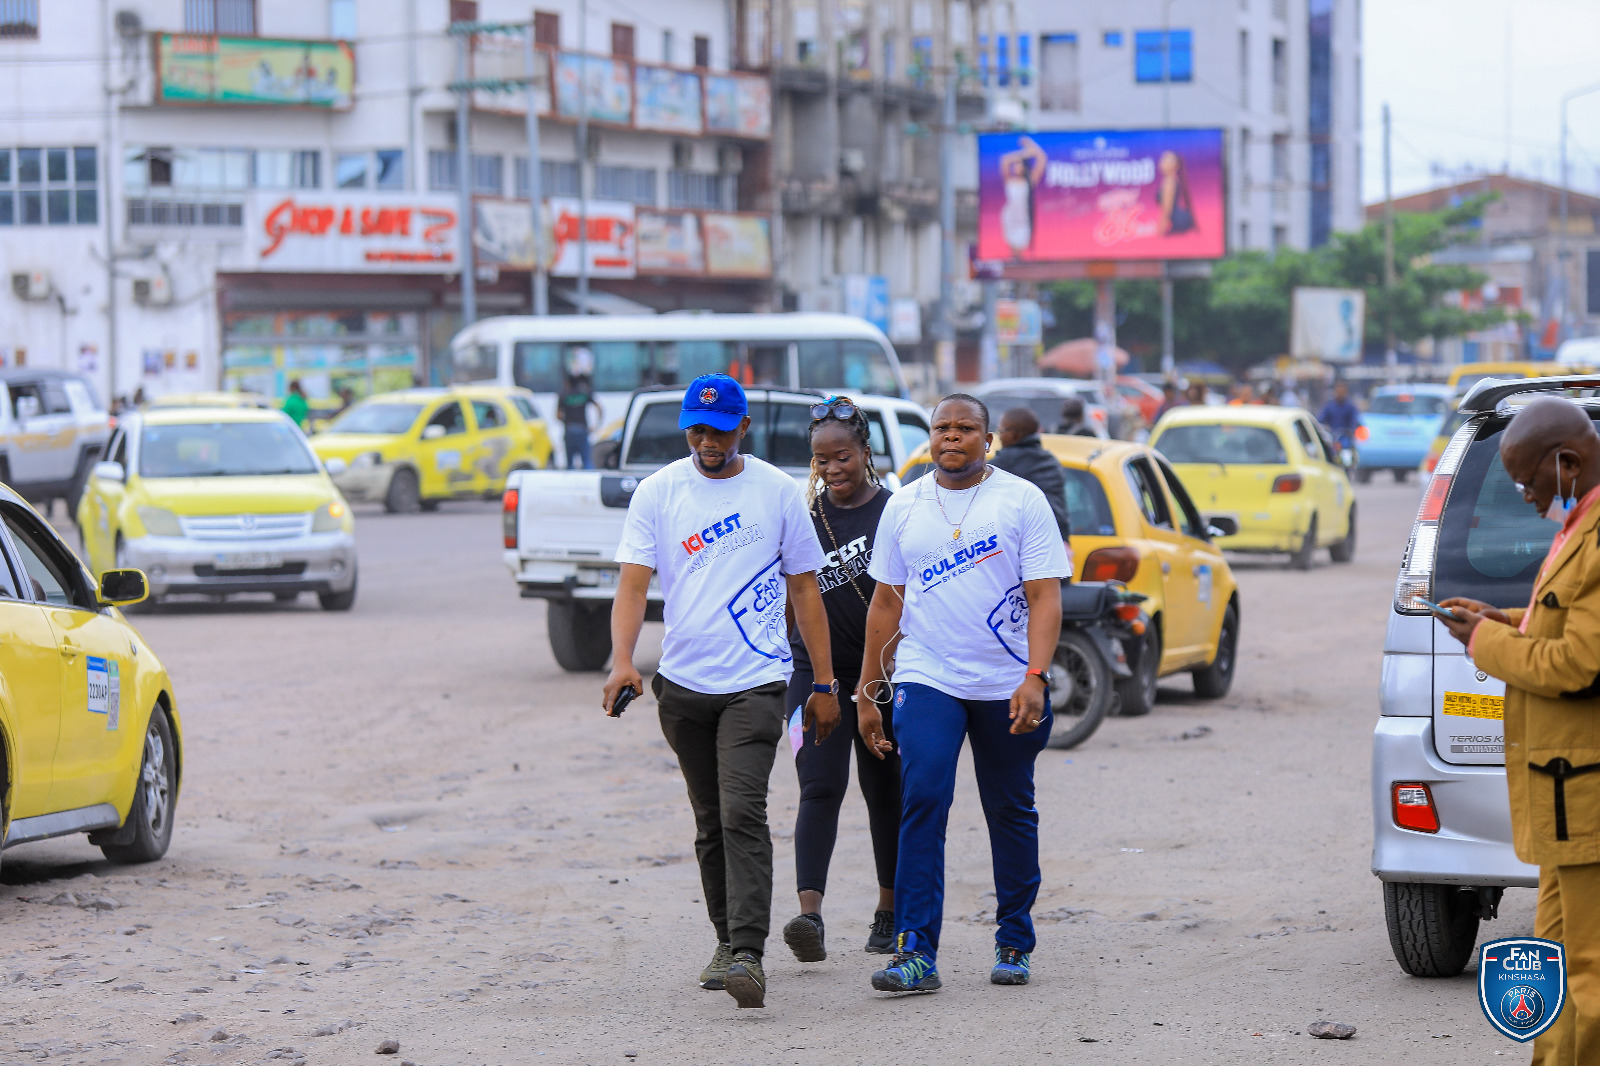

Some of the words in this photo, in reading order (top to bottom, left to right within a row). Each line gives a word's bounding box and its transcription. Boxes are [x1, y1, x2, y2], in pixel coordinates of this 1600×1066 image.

[681, 533, 705, 556] ICI
[701, 512, 742, 544] C'EST
[941, 573, 952, 583] BY
[89, 683, 108, 699] 2230AP
[1449, 735, 1493, 743] TERIOS
[1463, 745, 1503, 753] DAIHATSU
